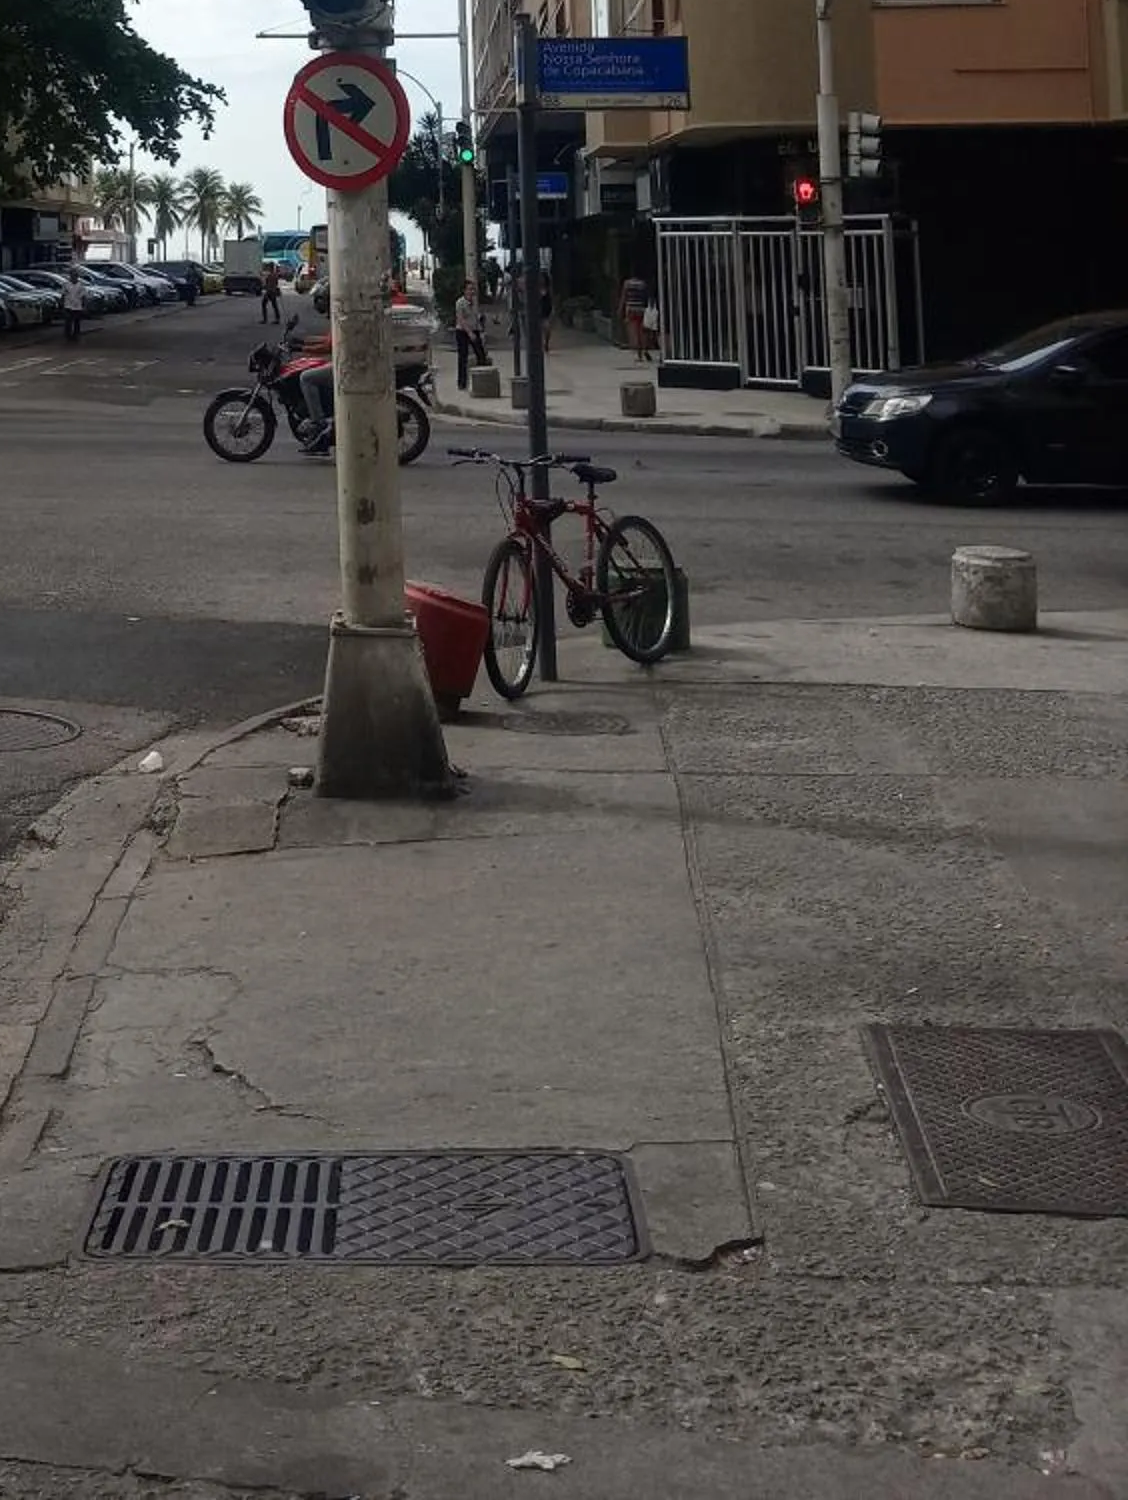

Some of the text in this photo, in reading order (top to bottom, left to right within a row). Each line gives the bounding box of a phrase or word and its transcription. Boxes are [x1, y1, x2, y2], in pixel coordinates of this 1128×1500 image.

[543, 41, 595, 54] Avenida
[543, 52, 641, 65] Nossa Senhora
[543, 64, 644, 78] de Copacabana
